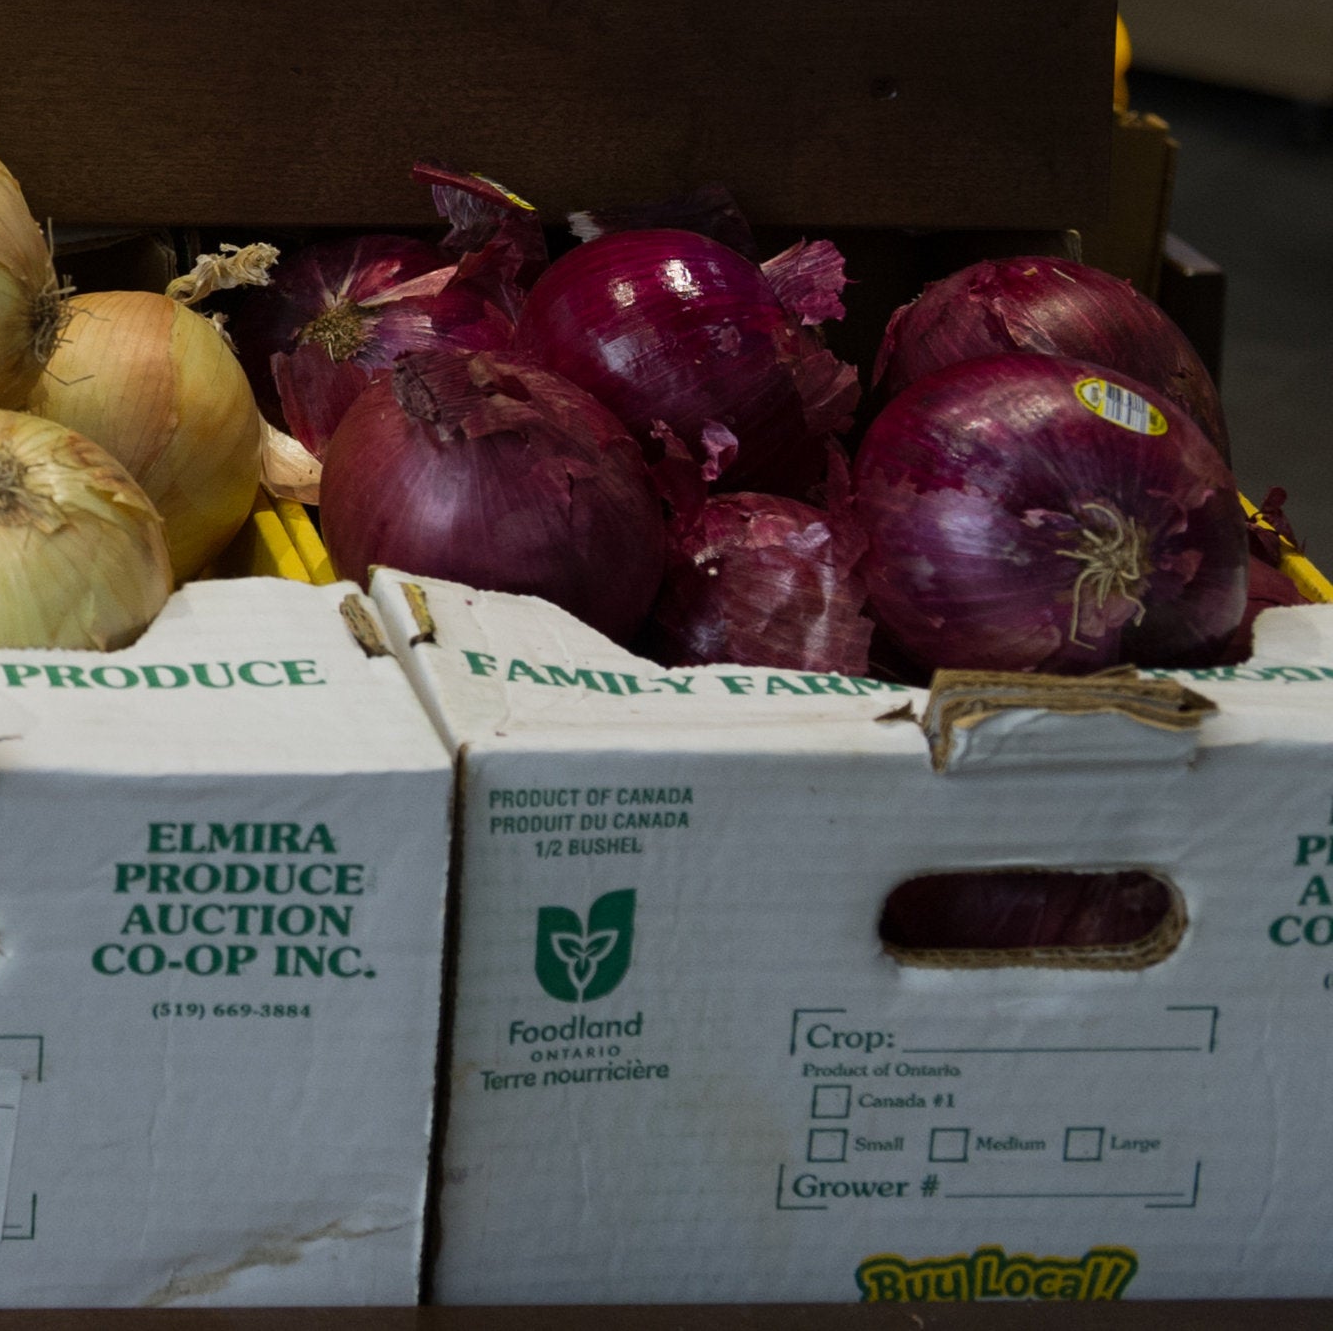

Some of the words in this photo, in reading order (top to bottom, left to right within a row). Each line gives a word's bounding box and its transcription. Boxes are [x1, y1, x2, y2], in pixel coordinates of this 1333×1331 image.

[1, 660, 326, 689] PRODUCE
[462, 650, 695, 695] FAMILY
[715, 673, 910, 695] FARM
[487, 789, 581, 810] PRODUCT
[617, 787, 693, 805] CANADA
[489, 814, 574, 835] PRODUIT
[613, 811, 689, 829] CANADA
[147, 823, 337, 854] ELMIRA
[535, 839, 562, 859] 1/2
[568, 837, 643, 856] BUSHEL
[114, 863, 364, 895] PRODUCE
[121, 904, 353, 936] AUCTION
[92, 943, 257, 976] CO-OP
[274, 945, 376, 979] INC.
[152, 1002, 206, 1020] (519)
[509, 1011, 643, 1045] Foodland
[806, 1023, 895, 1054] Crop:
[530, 1045, 621, 1063] ONTARIO
[480, 1070, 536, 1091] Terre
[542, 1059, 669, 1087] nourricière
[933, 1093, 955, 1108] #1
[1110, 1135, 1161, 1153] Large
[792, 1174, 909, 1198] Grower
